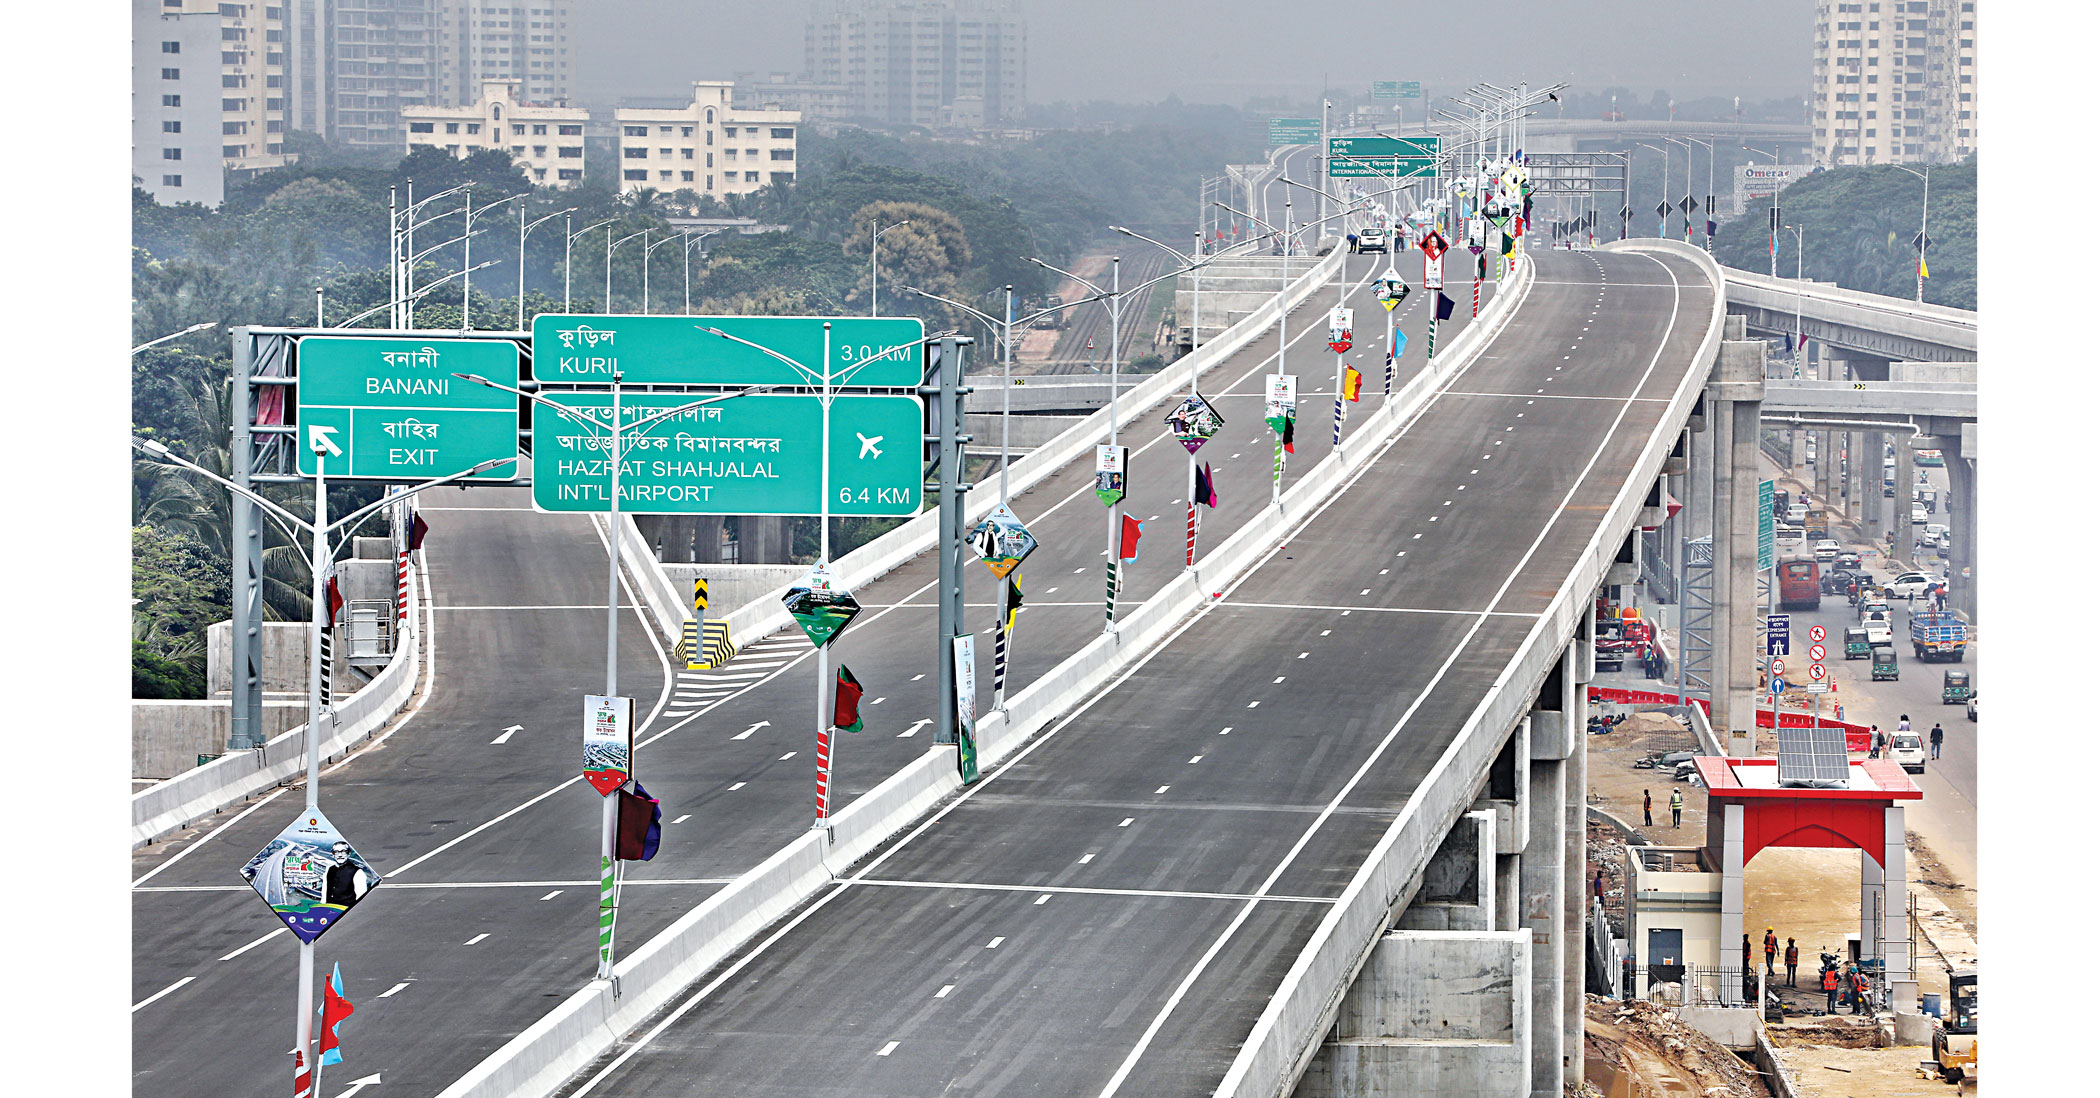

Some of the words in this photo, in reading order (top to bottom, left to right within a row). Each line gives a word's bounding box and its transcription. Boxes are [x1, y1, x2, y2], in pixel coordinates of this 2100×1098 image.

[1745, 168, 1784, 177] Omera
[556, 325, 617, 350] কুড়িল
[381, 346, 441, 368] বনানী
[841, 345, 871, 361] 3.0
[879, 345, 911, 362] KM
[560, 357, 625, 374] KURIL
[366, 377, 449, 395] BANANI
[381, 417, 440, 440] বাহির
[675, 432, 782, 453] বিমানবন্দর
[389, 448, 439, 465] EXIT
[558, 460, 646, 477] HAZRAT
[652, 461, 779, 478] SHAHJALAL
[558, 484, 609, 500] INT'L
[618, 485, 713, 502] AIRPORT
[839, 487, 870, 504] 6.4
[878, 488, 910, 504] KM
[1773, 663, 1783, 671] 40
